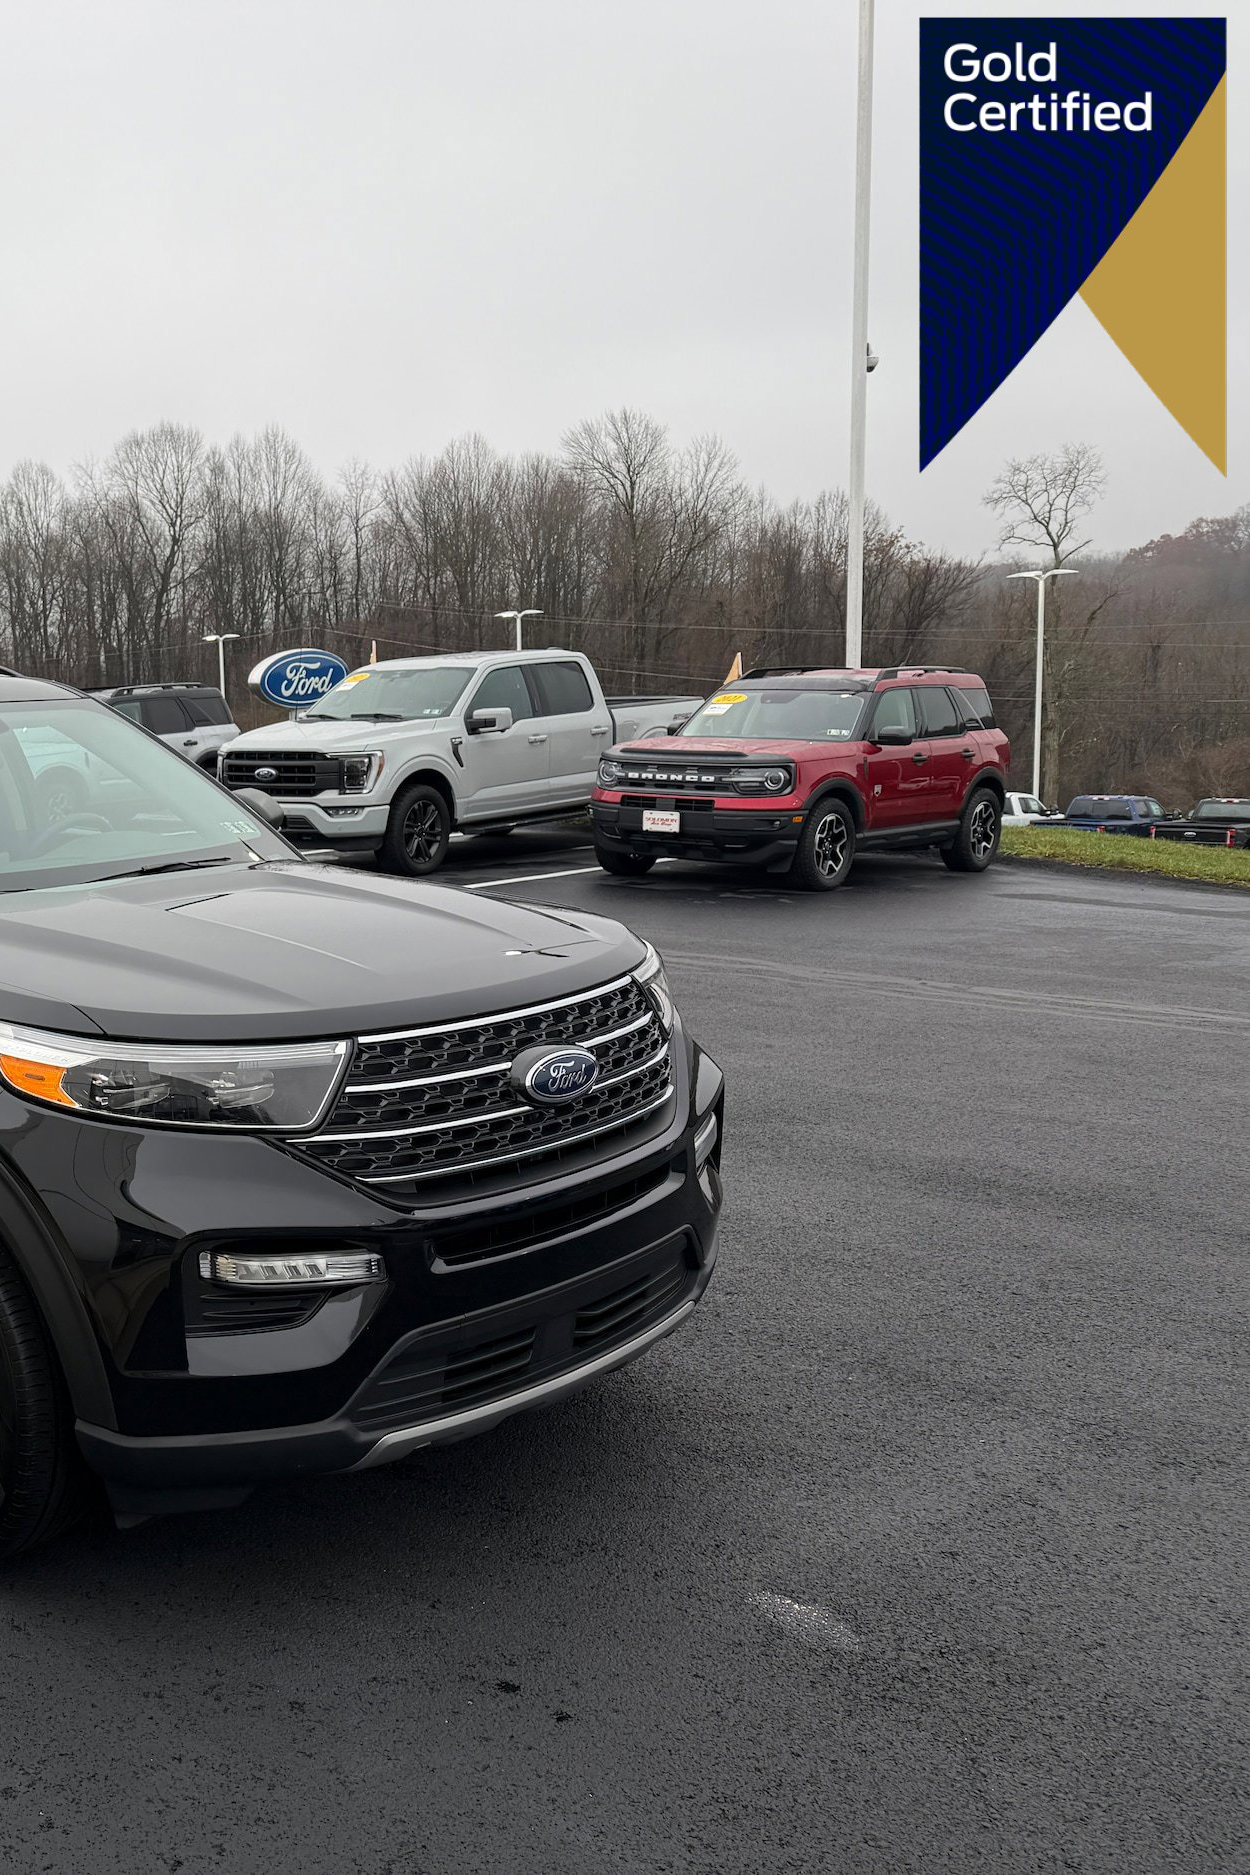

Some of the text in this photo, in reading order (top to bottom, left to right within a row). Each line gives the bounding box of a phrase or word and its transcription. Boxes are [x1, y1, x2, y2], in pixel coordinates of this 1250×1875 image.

[281, 662, 334, 697] Ford
[628, 772, 715, 782] BRONCO
[548, 1060, 587, 1093] Ford
